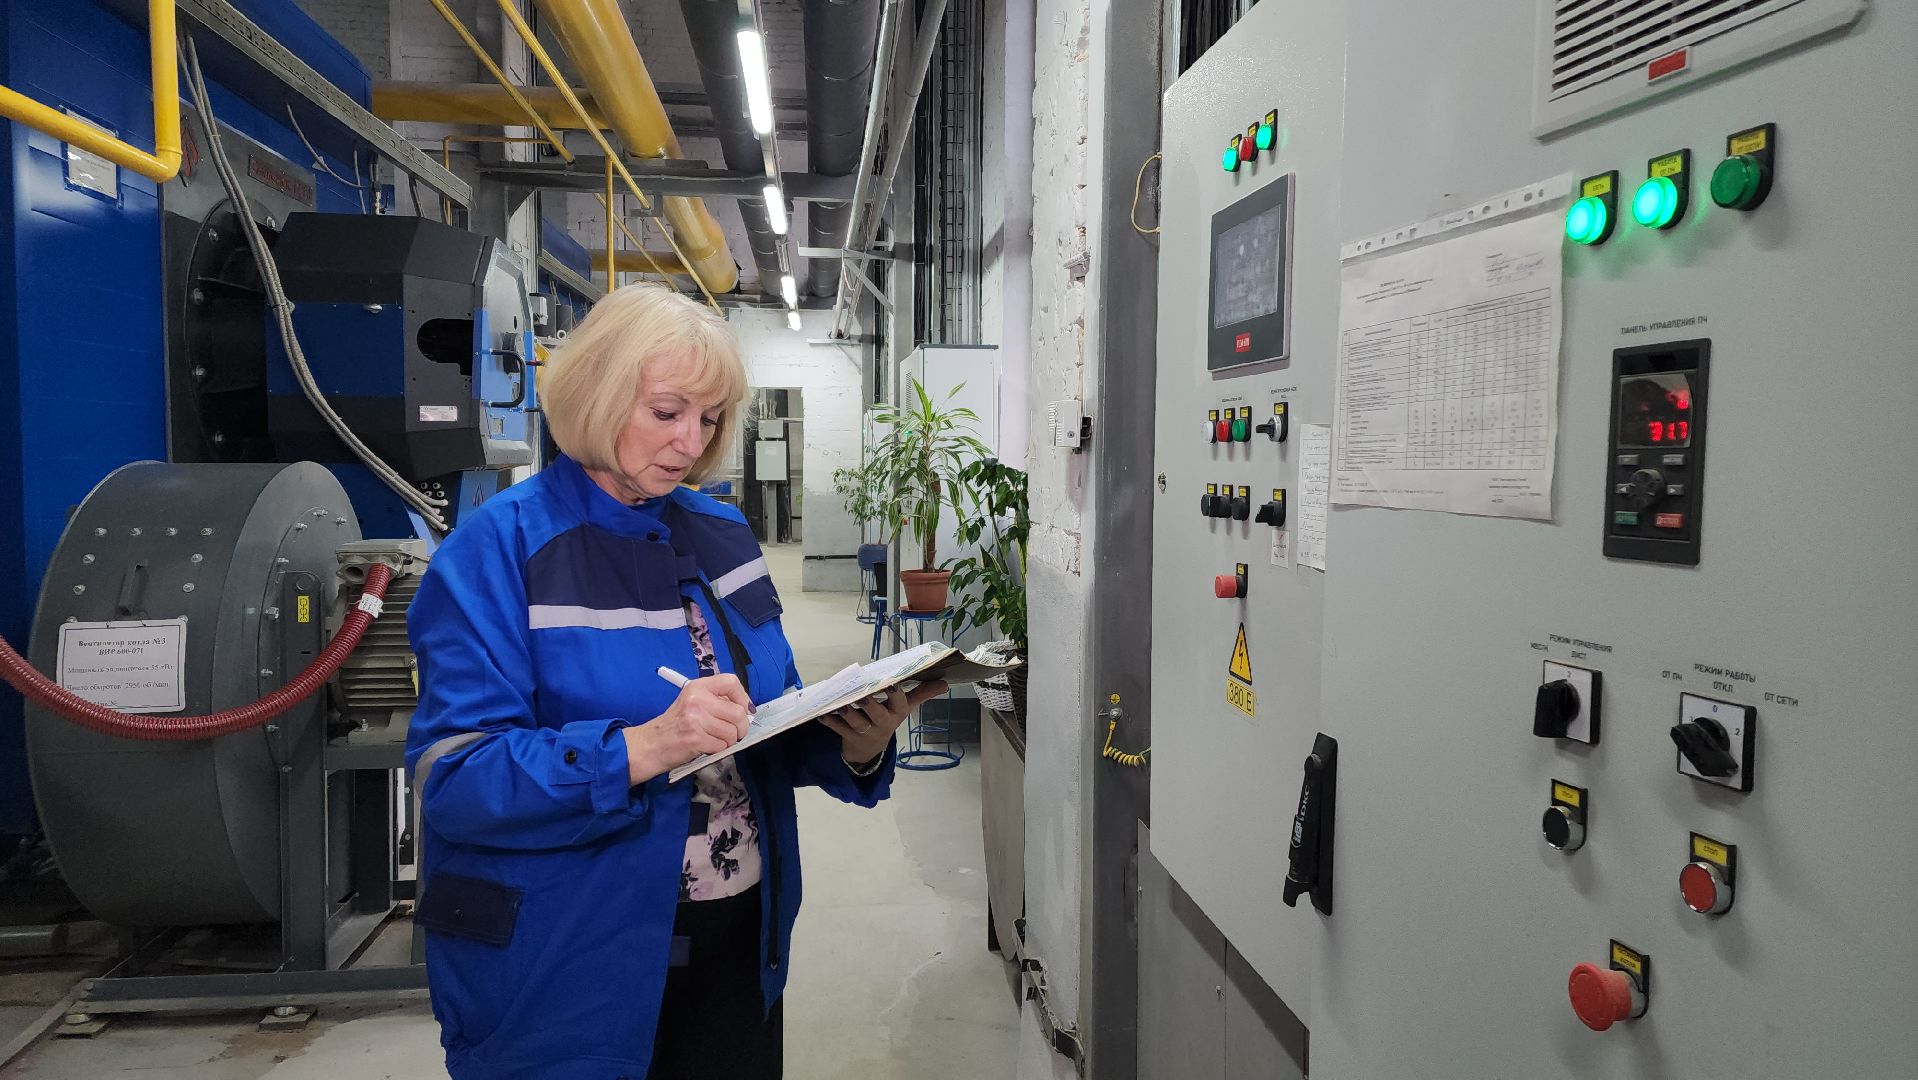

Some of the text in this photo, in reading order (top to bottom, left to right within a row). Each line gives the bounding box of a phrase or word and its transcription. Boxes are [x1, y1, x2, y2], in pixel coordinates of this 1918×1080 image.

[1621, 315, 1708, 335] ПАНЕЛЬ УПРАВЛЕНИЯ ПЧ
[1661, 670, 1683, 681] ОТ ПЧ
[1694, 663, 1756, 684] РЕЖИМ РАБОТЫ
[1228, 682, 1244, 708] 380
[1713, 680, 1734, 693] ОТКЛ
[1764, 691, 1799, 708] ОТ СЕТИ
[1735, 727, 1741, 737] 2
[1301, 785, 1312, 817] DKC
